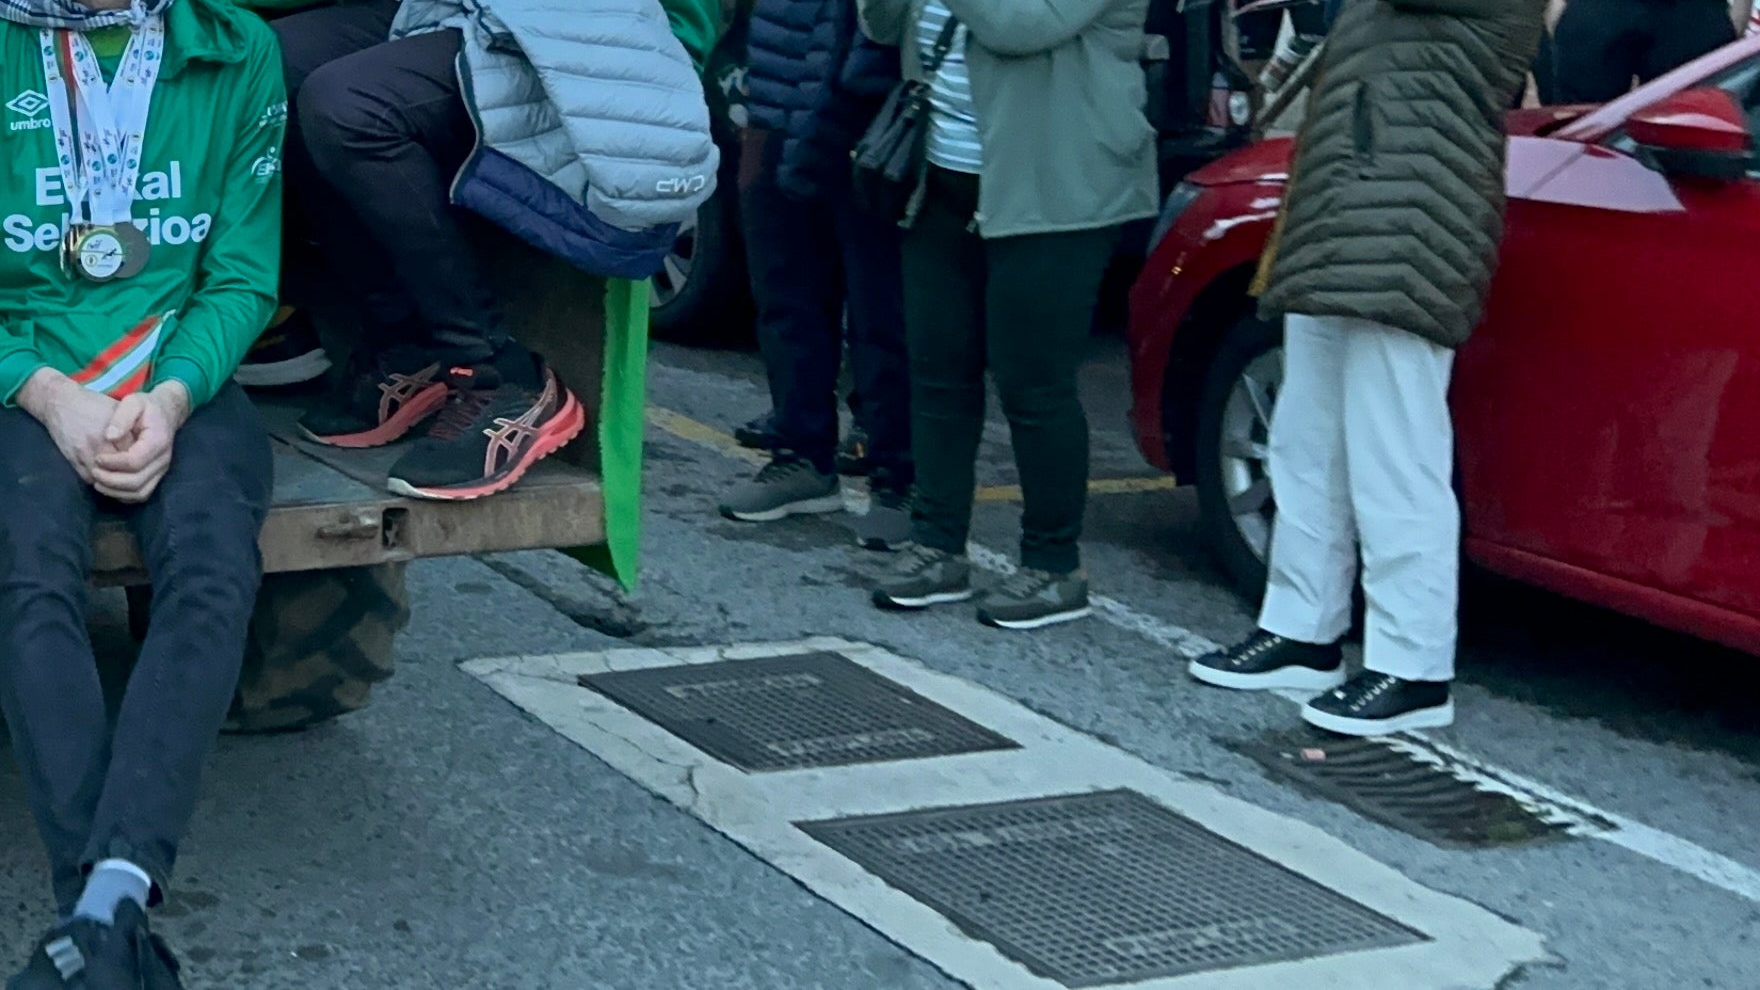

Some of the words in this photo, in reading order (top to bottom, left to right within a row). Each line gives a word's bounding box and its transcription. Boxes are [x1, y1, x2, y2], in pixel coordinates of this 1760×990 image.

[10, 117, 51, 131] umbro
[35, 161, 182, 206] Eal
[3, 208, 212, 252] Selioa
